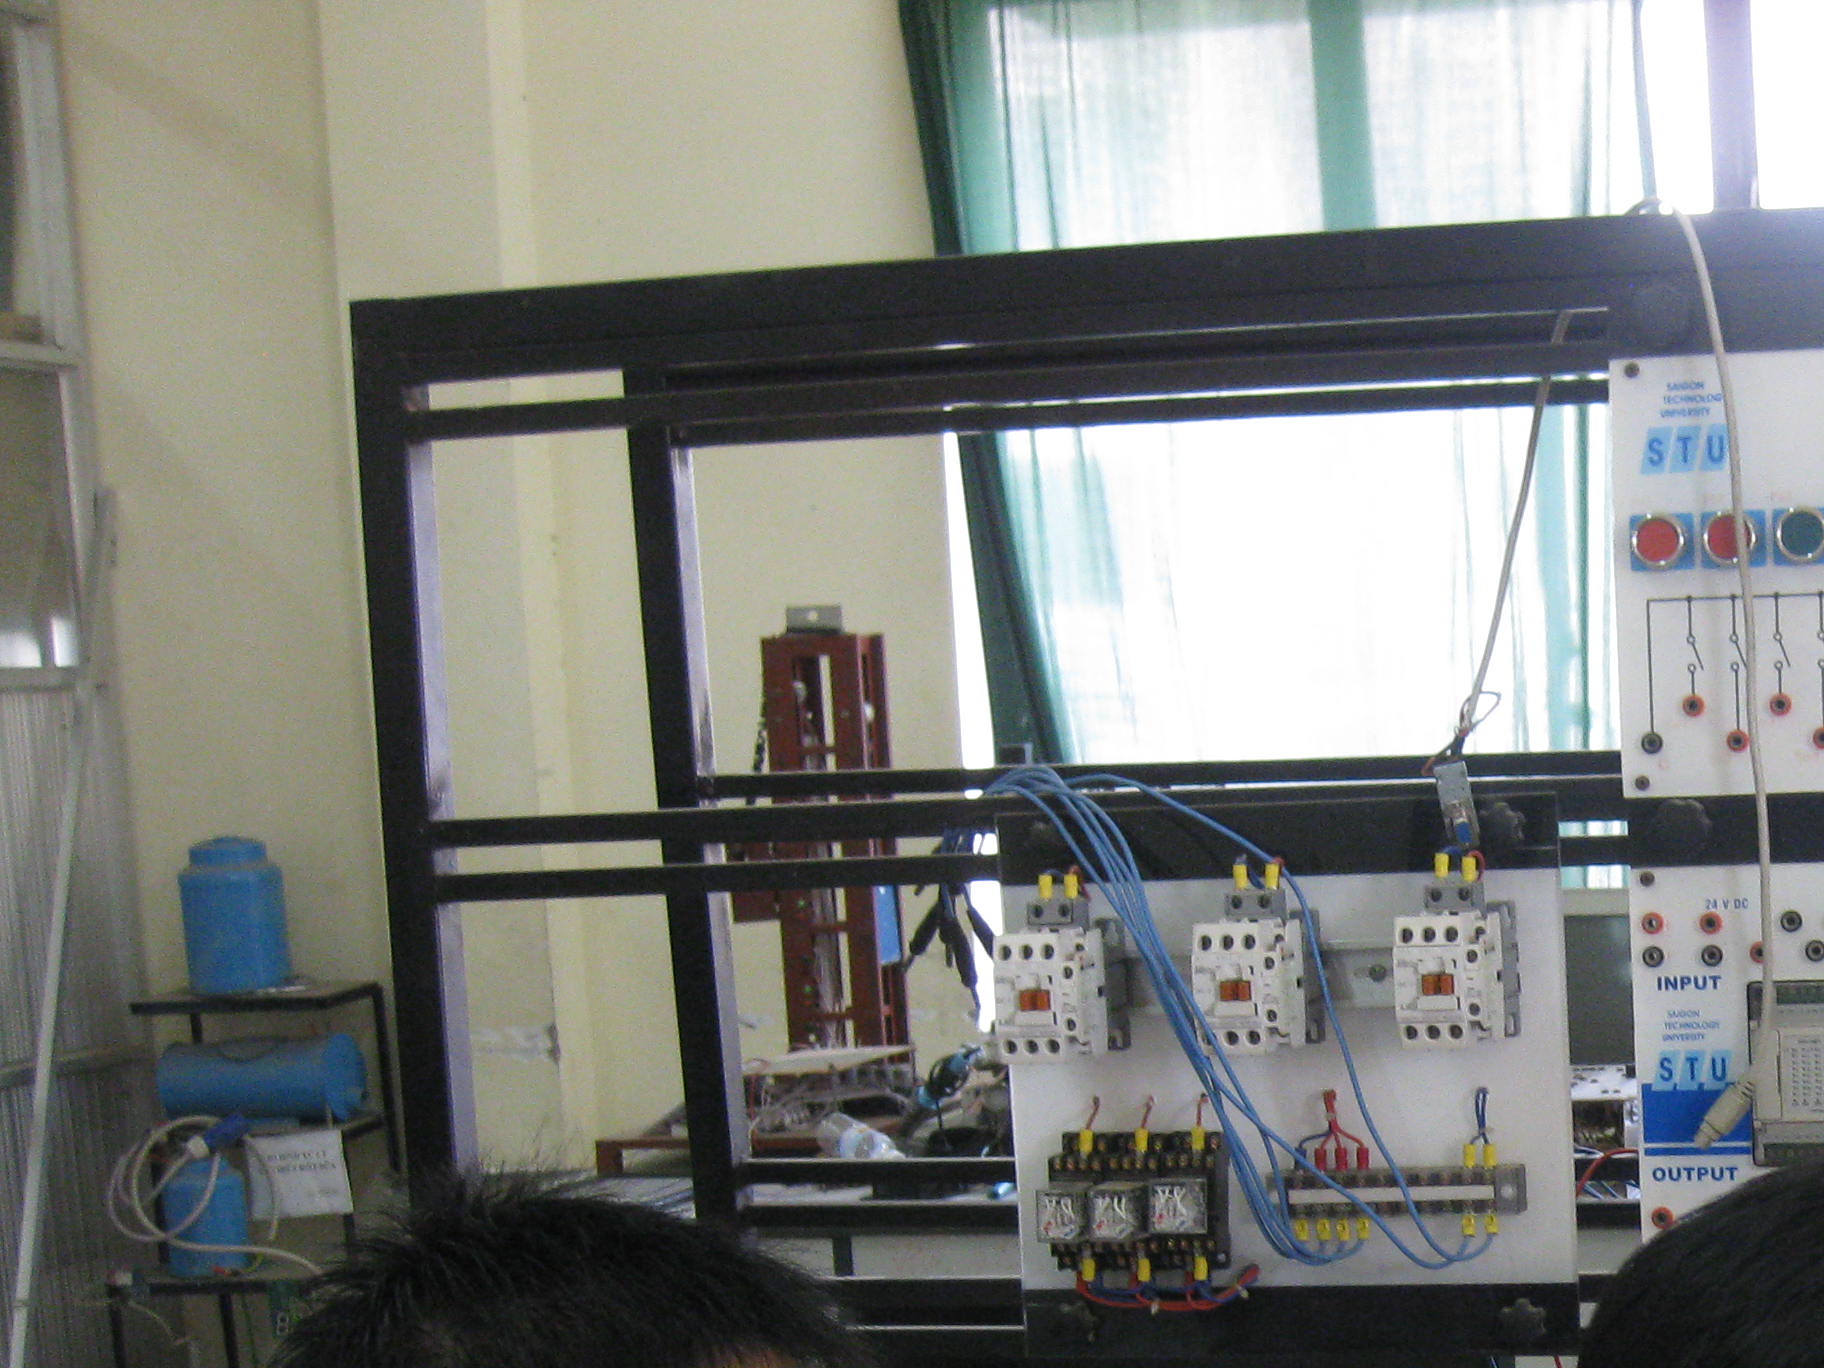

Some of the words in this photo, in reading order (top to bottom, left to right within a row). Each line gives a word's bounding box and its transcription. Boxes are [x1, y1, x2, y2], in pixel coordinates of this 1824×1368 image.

[1647, 435, 1725, 467] STU
[1722, 898, 1731, 910] V
[1656, 974, 1722, 991] INPUT
[1667, 1009, 1701, 1018] SAIGON
[1664, 1020, 1720, 1030] TECHNOLOGY
[1662, 1032, 1705, 1042] UNIVERSITY
[1659, 1056, 1727, 1082] STU
[1652, 1165, 1738, 1183] OUTPUT
